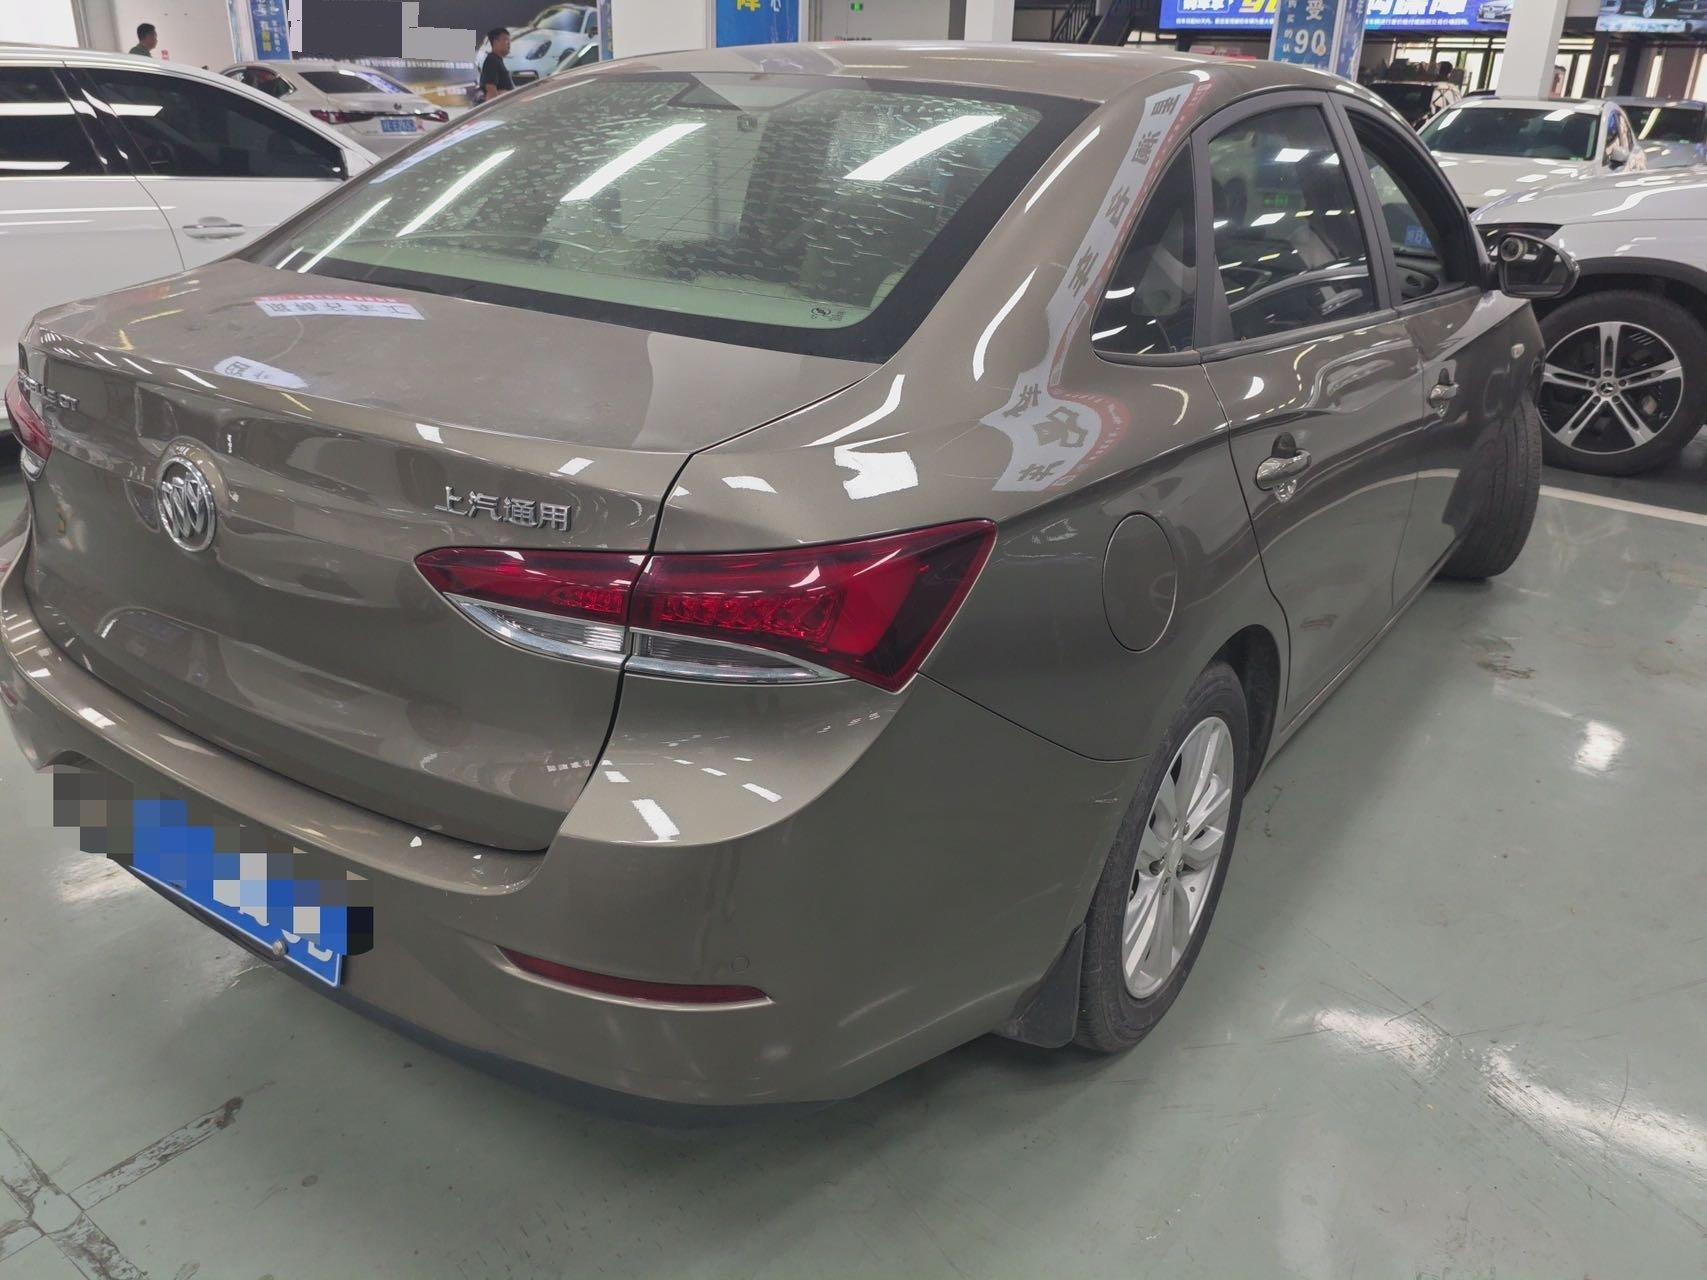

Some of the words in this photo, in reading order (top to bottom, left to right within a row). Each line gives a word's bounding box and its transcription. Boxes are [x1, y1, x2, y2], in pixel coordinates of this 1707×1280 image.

[1294, 29, 1326, 56] 90
[433, 485, 573, 532] 上汽通用
